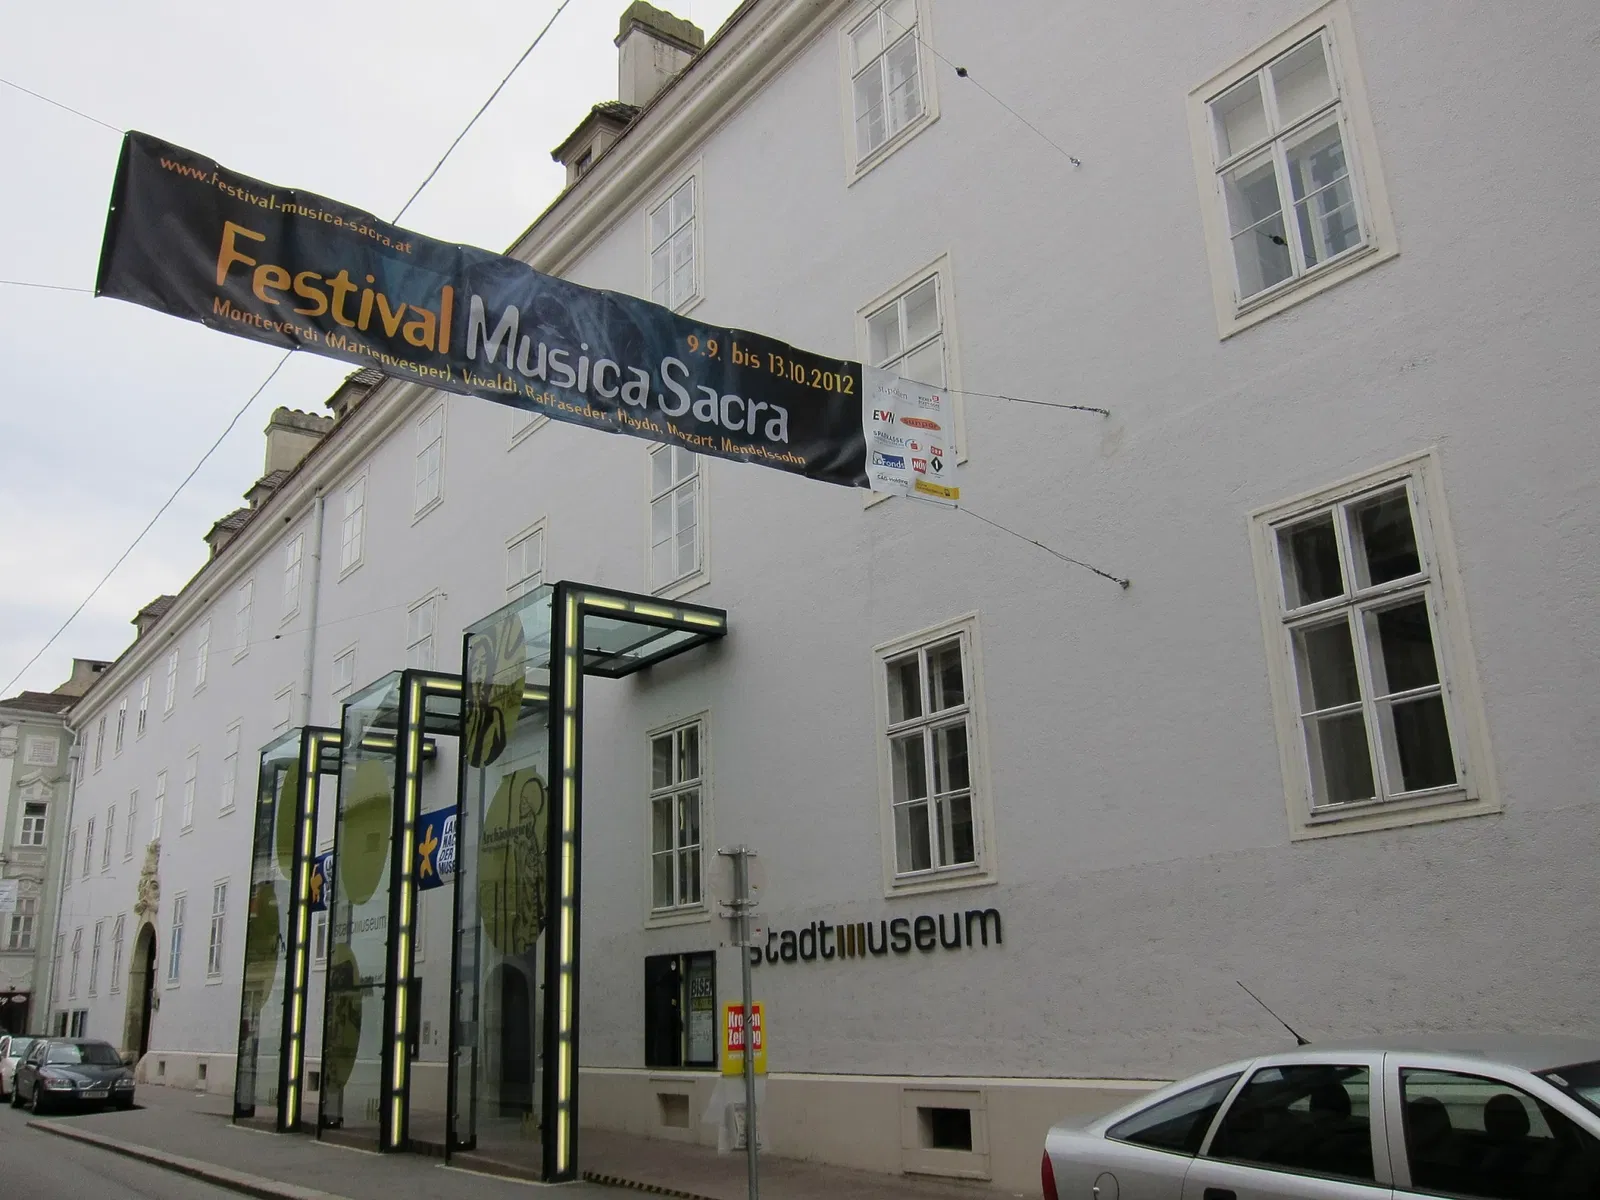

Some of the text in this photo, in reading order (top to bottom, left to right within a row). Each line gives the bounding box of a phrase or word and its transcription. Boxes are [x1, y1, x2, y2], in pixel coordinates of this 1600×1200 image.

[160, 157, 412, 254] www.festival-musica-sacra.at
[216, 220, 454, 354] Festival
[213, 296, 806, 465] Monteverdi (Marienvesper), Vivaldi, Raffaseder, Haydn, Mozart, Mendelssohn
[687, 334, 854, 395] 9.9. bis 13.10.2012
[873, 409, 895, 424] EVN
[728, 1011, 760, 1028] Kroen
